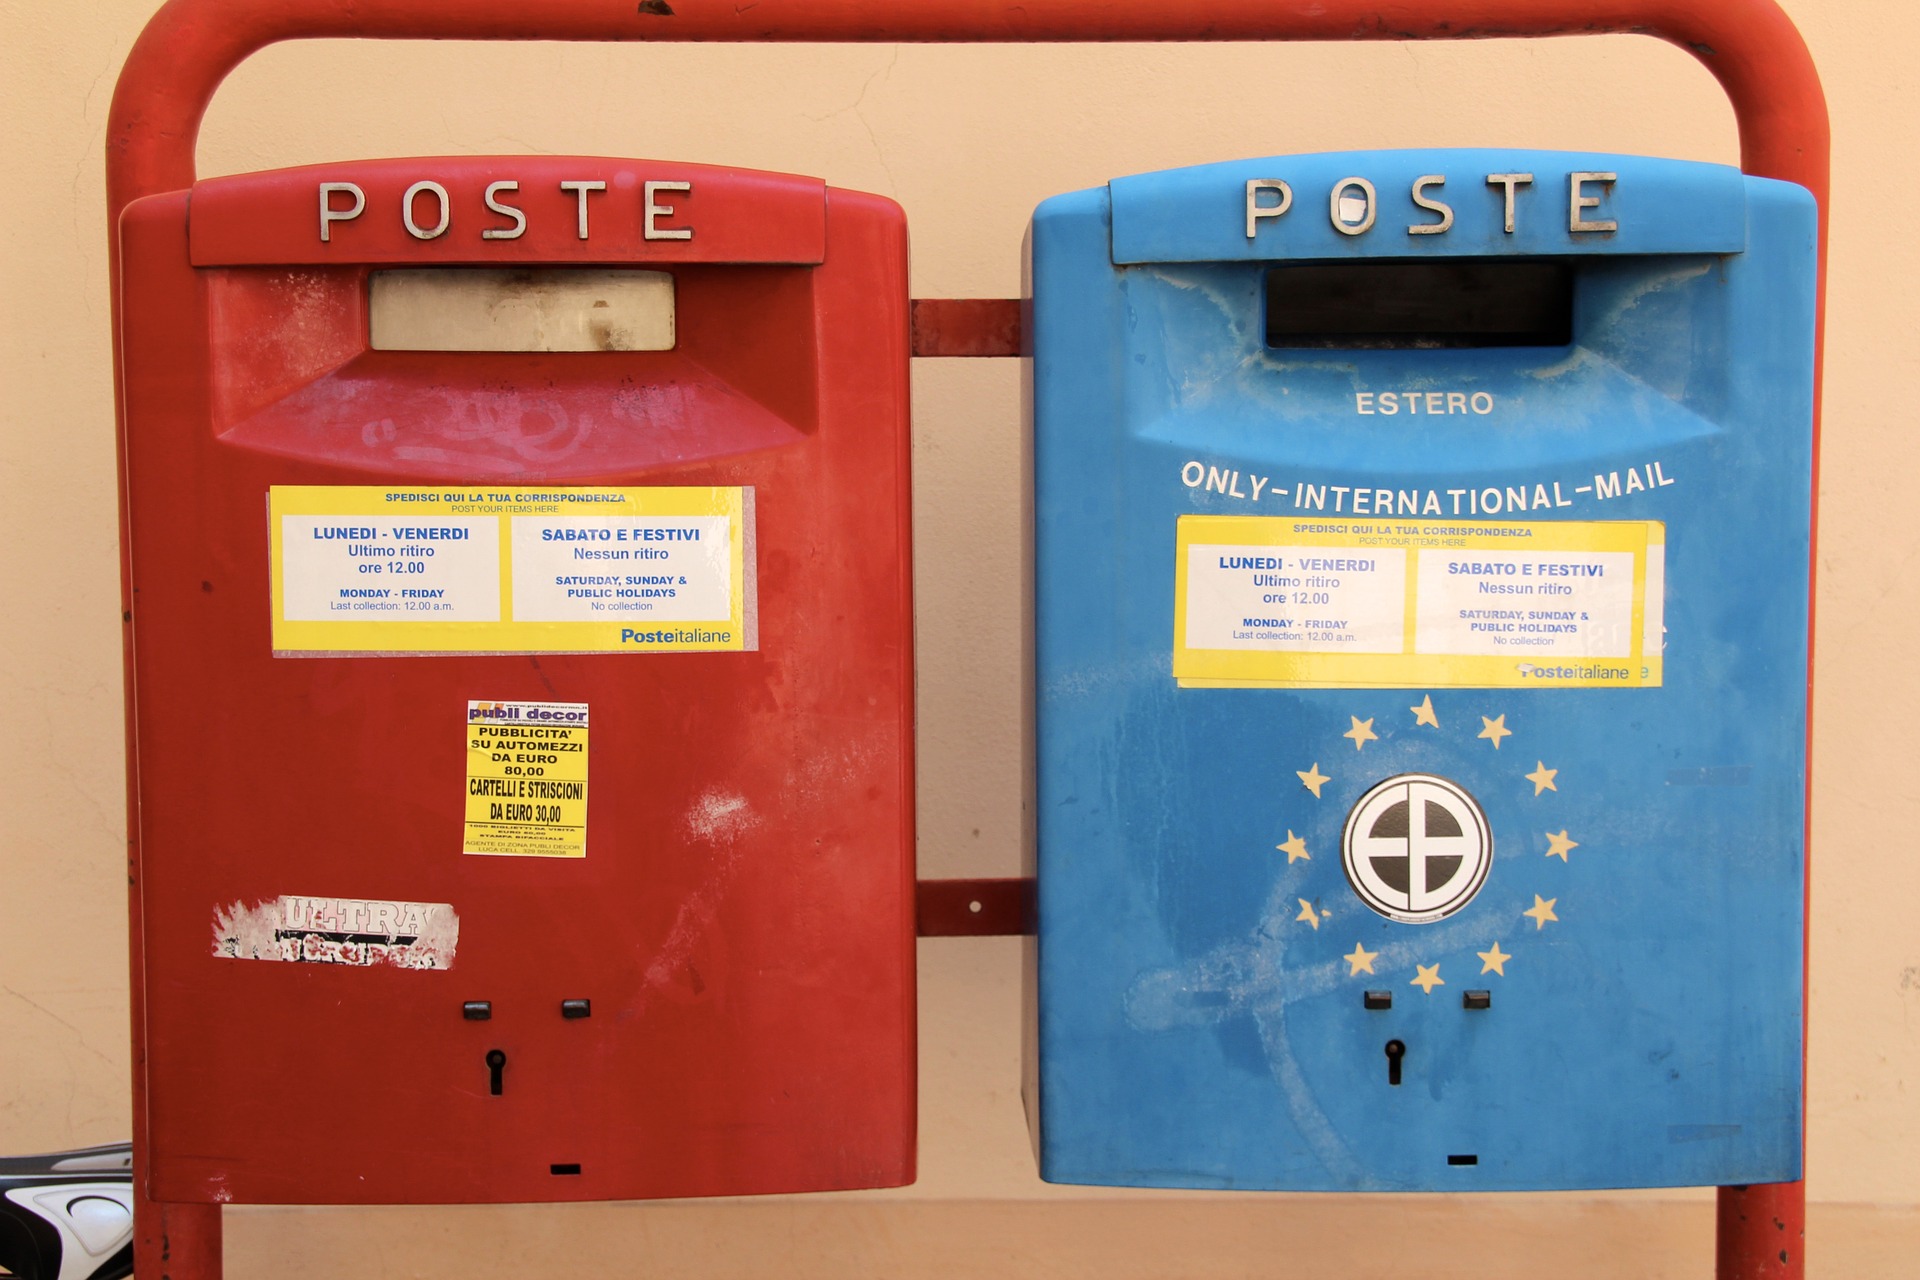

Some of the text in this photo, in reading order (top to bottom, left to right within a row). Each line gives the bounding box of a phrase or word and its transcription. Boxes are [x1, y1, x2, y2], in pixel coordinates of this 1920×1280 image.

[319, 180, 693, 242] POSTE
[1246, 171, 1618, 239] POSTE
[1356, 391, 1495, 416] ESTERO
[385, 493, 626, 503] SPEDISCI QUI LA TUA CORRISPONDENZA
[452, 505, 559, 513] POST YOUR ITEMS HERE
[313, 527, 377, 540] LUNEDI
[393, 527, 470, 540] VENERDI
[542, 528, 700, 541] SABATO E FESTIVI
[1293, 524, 1533, 537] SPEDISCI QUI LA TUA CORRISPONDENZA
[1359, 537, 1467, 546] POST YOUR ITEMS HERE
[348, 544, 435, 557] Ultimo ritiro
[574, 547, 669, 560] Nessun ritiro
[358, 561, 425, 574] ore 12.00
[1219, 557, 1283, 570] LUNEDI
[1299, 559, 1376, 572] VENERDI
[1448, 562, 1604, 577] SABATO E FESTIVI
[555, 576, 687, 587] SATURDAY, SUNDAY &
[1253, 574, 1341, 588] Ultimo ritiro
[339, 589, 390, 598] MONDAY
[401, 589, 445, 598] FRIDAY
[567, 589, 676, 598] PUBLIC HOLIDAYS
[1478, 581, 1573, 596] Nessun ritiro
[1263, 592, 1330, 605] ore 12.00
[330, 601, 455, 611] Last collection: 12.00 a.m.
[591, 602, 653, 611] No collection
[1459, 609, 1589, 621] SATURDAY, SUNDAY &
[1242, 618, 1294, 628] MONDAY
[1304, 620, 1349, 629] FRIDAY
[1470, 622, 1577, 633] PUBLIC HOLIDAYS
[621, 629, 731, 644] Posteitaliane
[1232, 630, 1357, 642] Last collection: 12.00 a.m.
[1493, 636, 1554, 646] No collection
[469, 707, 520, 719] publi
[526, 708, 588, 721] decor
[471, 739, 583, 752] SU AUTOMEZZI
[492, 753, 558, 764] DA EURO
[504, 766, 544, 777] 80,00
[470, 778, 583, 800] CARTELLI E STRISCIONI
[490, 803, 561, 826] DA EURO 30,00
